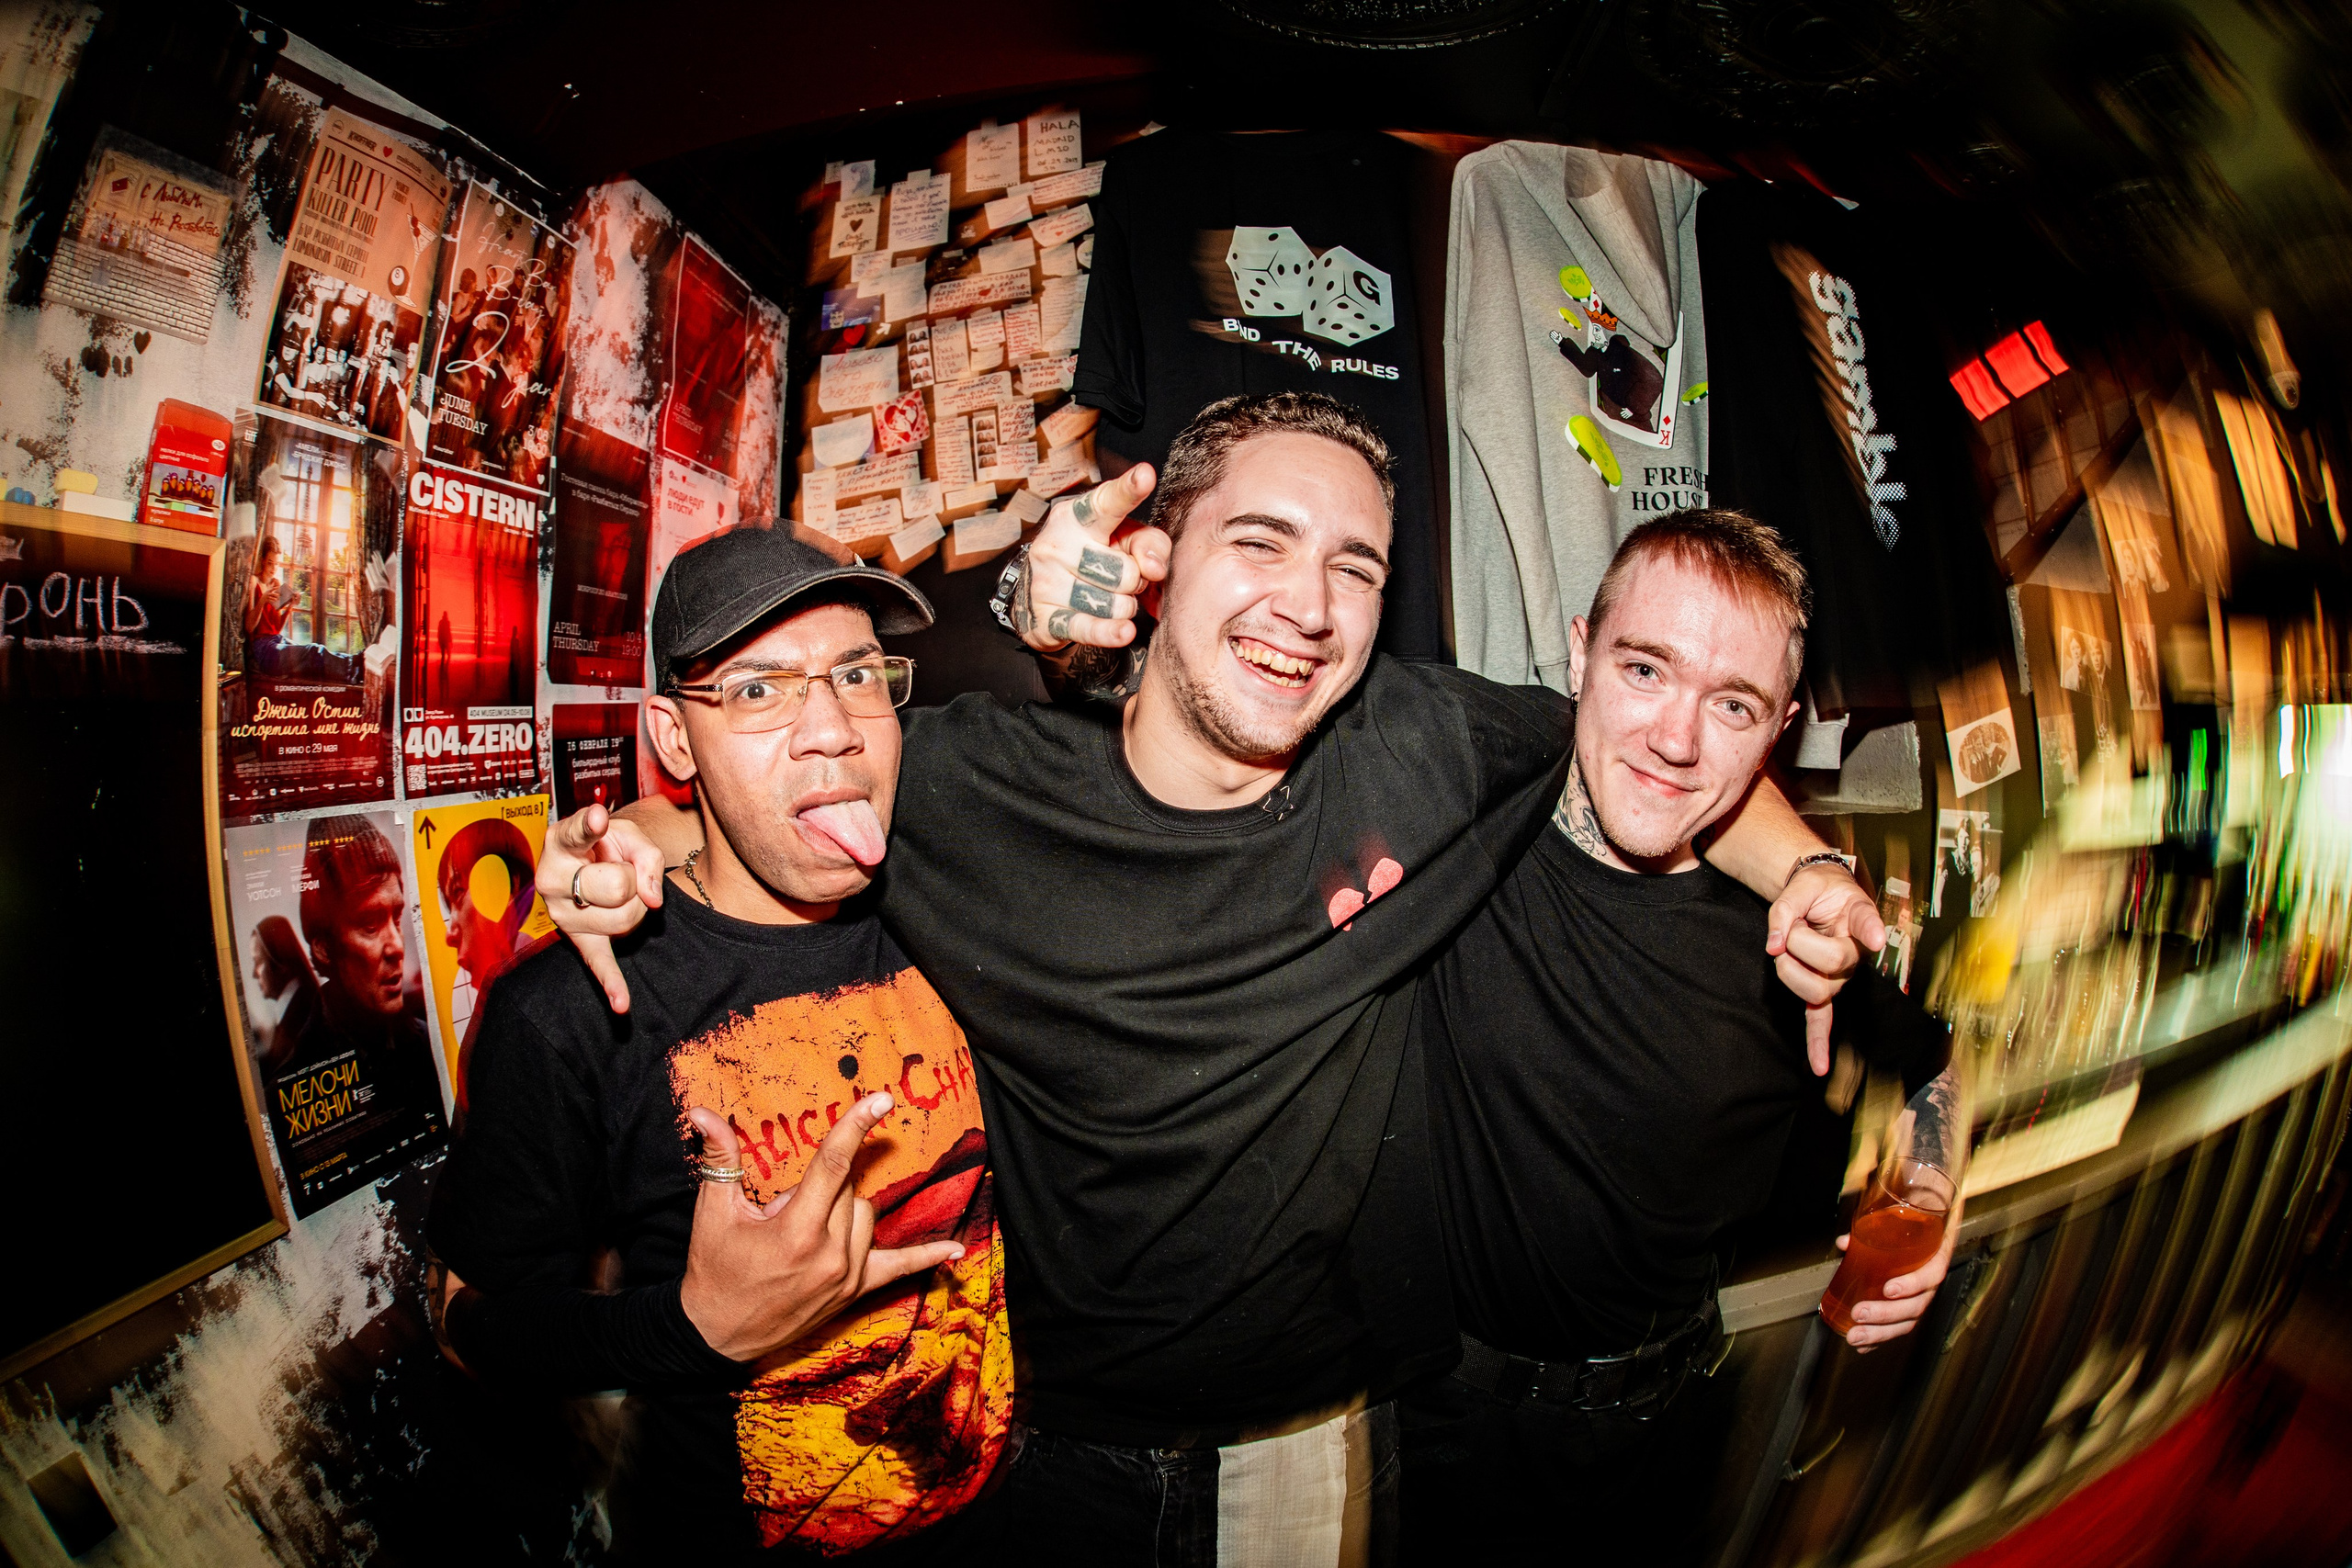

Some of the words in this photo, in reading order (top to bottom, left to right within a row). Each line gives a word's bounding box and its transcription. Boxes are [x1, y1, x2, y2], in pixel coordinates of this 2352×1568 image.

[1040, 119, 1080, 133] HALA
[314, 146, 394, 212] PARTY
[307, 186, 349, 224] KILLER
[350, 207, 379, 238] POOL
[1352, 270, 1381, 307] G
[446, 310, 509, 380] 2
[1222, 318, 1261, 342] BND
[1272, 340, 1322, 371] THE
[1330, 358, 1400, 381] RULES
[440, 392, 471, 414] JUNE
[438, 408, 489, 435] TUESDAY
[1643, 466, 1710, 492] FRESH
[410, 471, 537, 532] CISTERN
[553, 621, 582, 636] APRIL
[627, 631, 642, 644] 104
[552, 636, 600, 652] THURSDAY
[254, 696, 309, 723] Джейн
[312, 696, 363, 719] Остин
[481, 708, 504, 717] MUSEUM
[231, 723, 310, 741] испортила
[312, 722, 339, 735] мне
[342, 722, 380, 741] жизнь
[404, 722, 534, 759] 404.ZERO
[311, 742, 322, 753] 29
[579, 739, 609, 750] ФЕВРАЛЯ
[571, 755, 608, 769] бильярдный
[607, 753, 621, 765] клуб
[573, 768, 602, 783] разбитых
[601, 767, 622, 778] сердец
[246, 887, 282, 902] УОТСОН
[292, 879, 320, 894] МЕРФИ
[278, 1059, 360, 1113] МЕЛОЧИ
[285, 1089, 353, 1140] ЖИЗНИ
